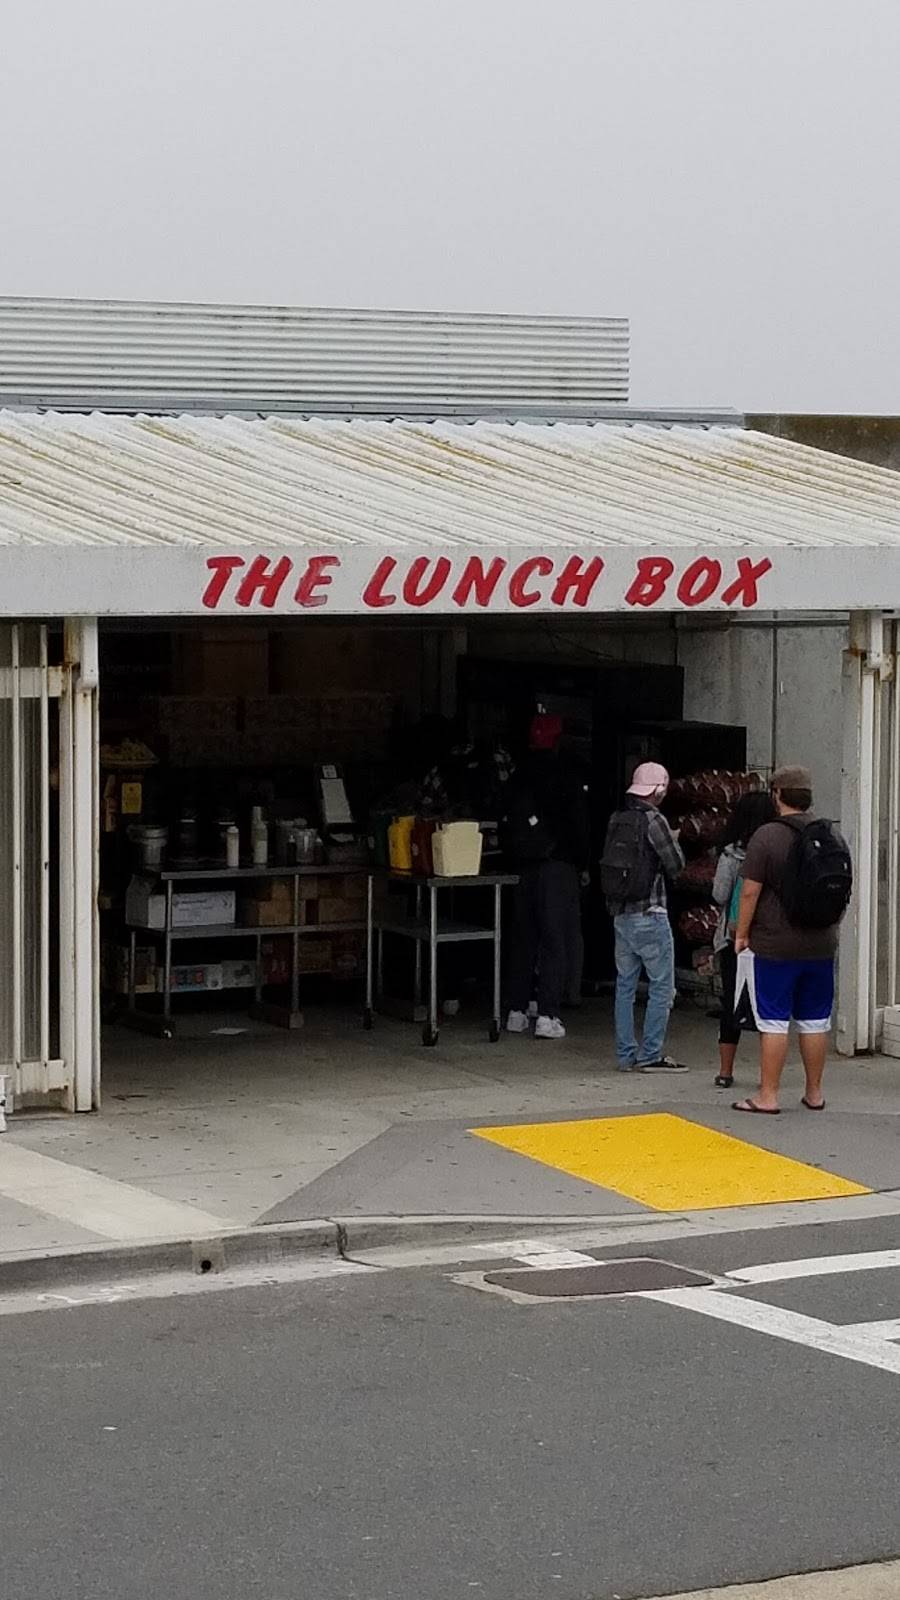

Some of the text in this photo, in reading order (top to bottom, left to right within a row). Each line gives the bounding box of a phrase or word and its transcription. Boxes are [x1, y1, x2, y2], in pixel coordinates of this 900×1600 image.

[202, 555, 772, 609] THE LUNCH BOX
